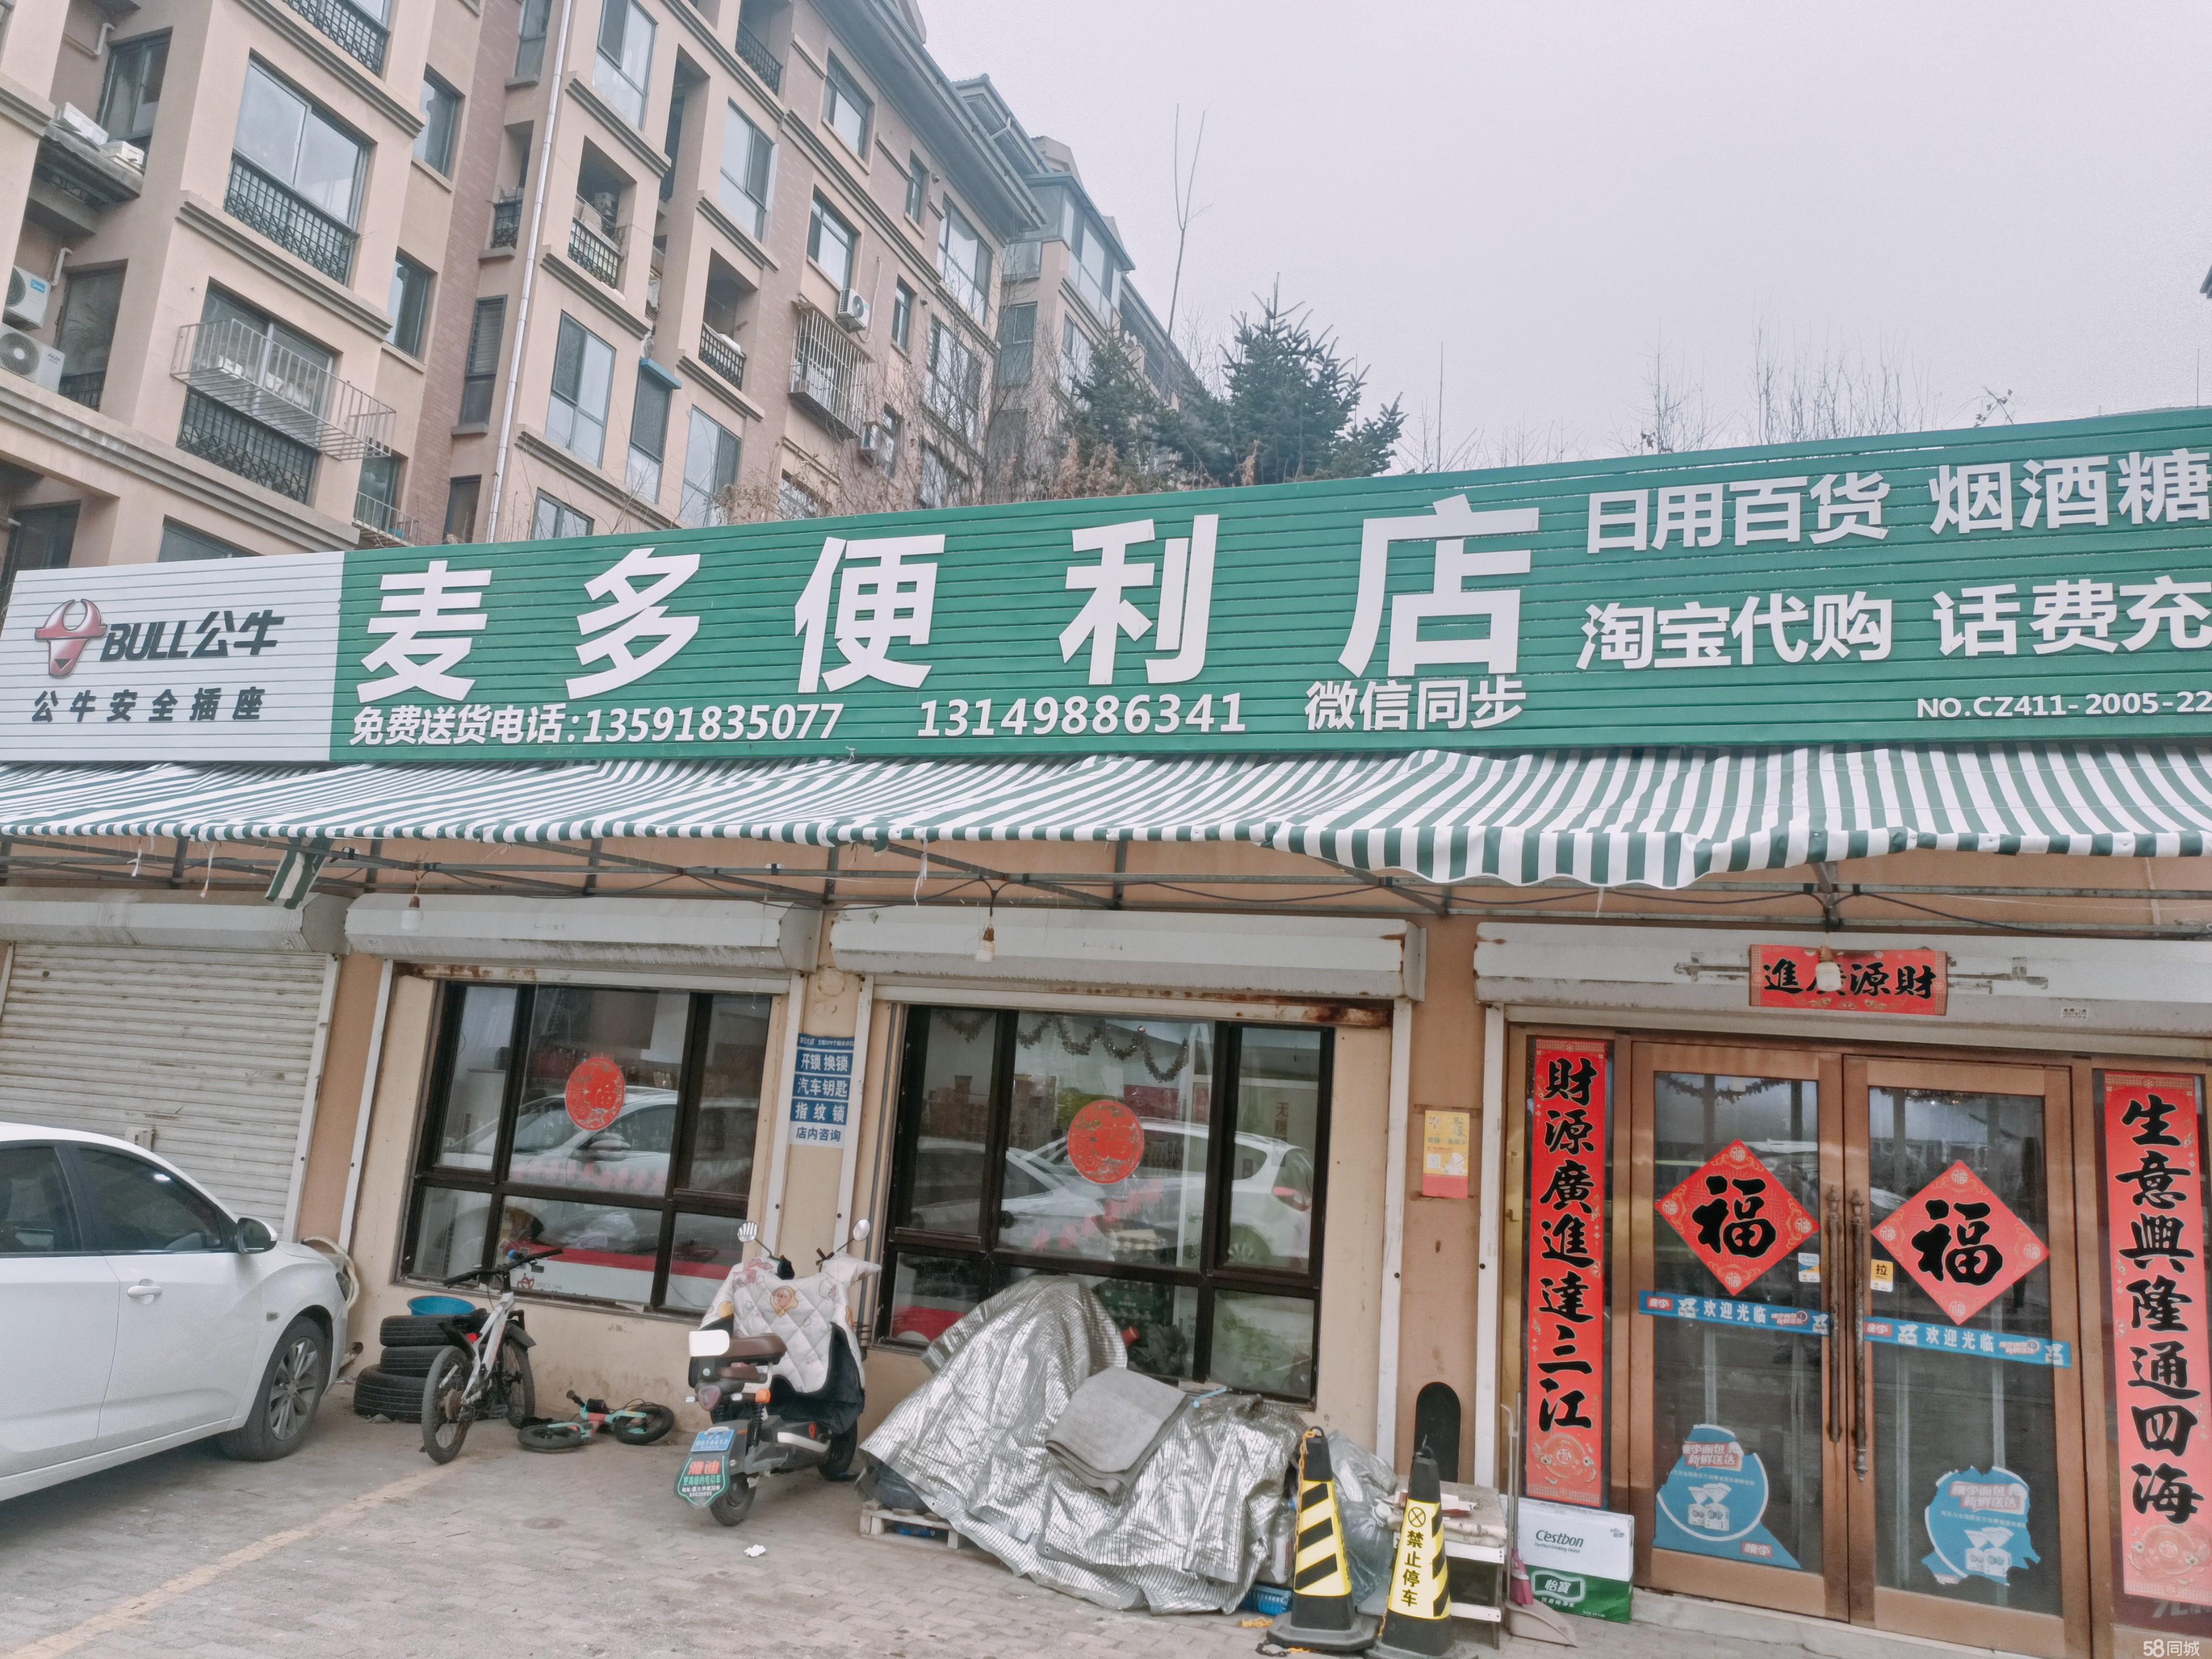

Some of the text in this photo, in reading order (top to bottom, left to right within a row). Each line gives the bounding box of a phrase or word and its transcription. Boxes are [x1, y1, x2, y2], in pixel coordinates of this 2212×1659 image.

[1587, 471, 1891, 554] 日用百货
[1928, 448, 2212, 535] 烟酒糖
[357, 494, 1539, 704] 麦多便利店
[1932, 575, 2212, 656] 话费充
[1576, 591, 1892, 670] 淘宝代购
[31, 686, 265, 723] 公牛安全插座
[918, 692, 1245, 737] 13149886341
[1304, 676, 1527, 731] 微信同步
[797, 1077, 847, 1097] 汽车钥匙
[801, 1053, 848, 1072] 开锁 换锁
[795, 1102, 845, 1123] 指纹锁
[796, 1127, 841, 1142] 店内咨询
[1691, 1175, 1777, 1259] 福
[1911, 1199, 2003, 1286] 福
[1876, 1264, 1888, 1275] 拉
[1703, 1299, 1766, 1324] 欢迎光临
[1925, 1326, 1994, 1352] 欢迎光临
[1402, 1530, 1425, 1607] 禁止停车
